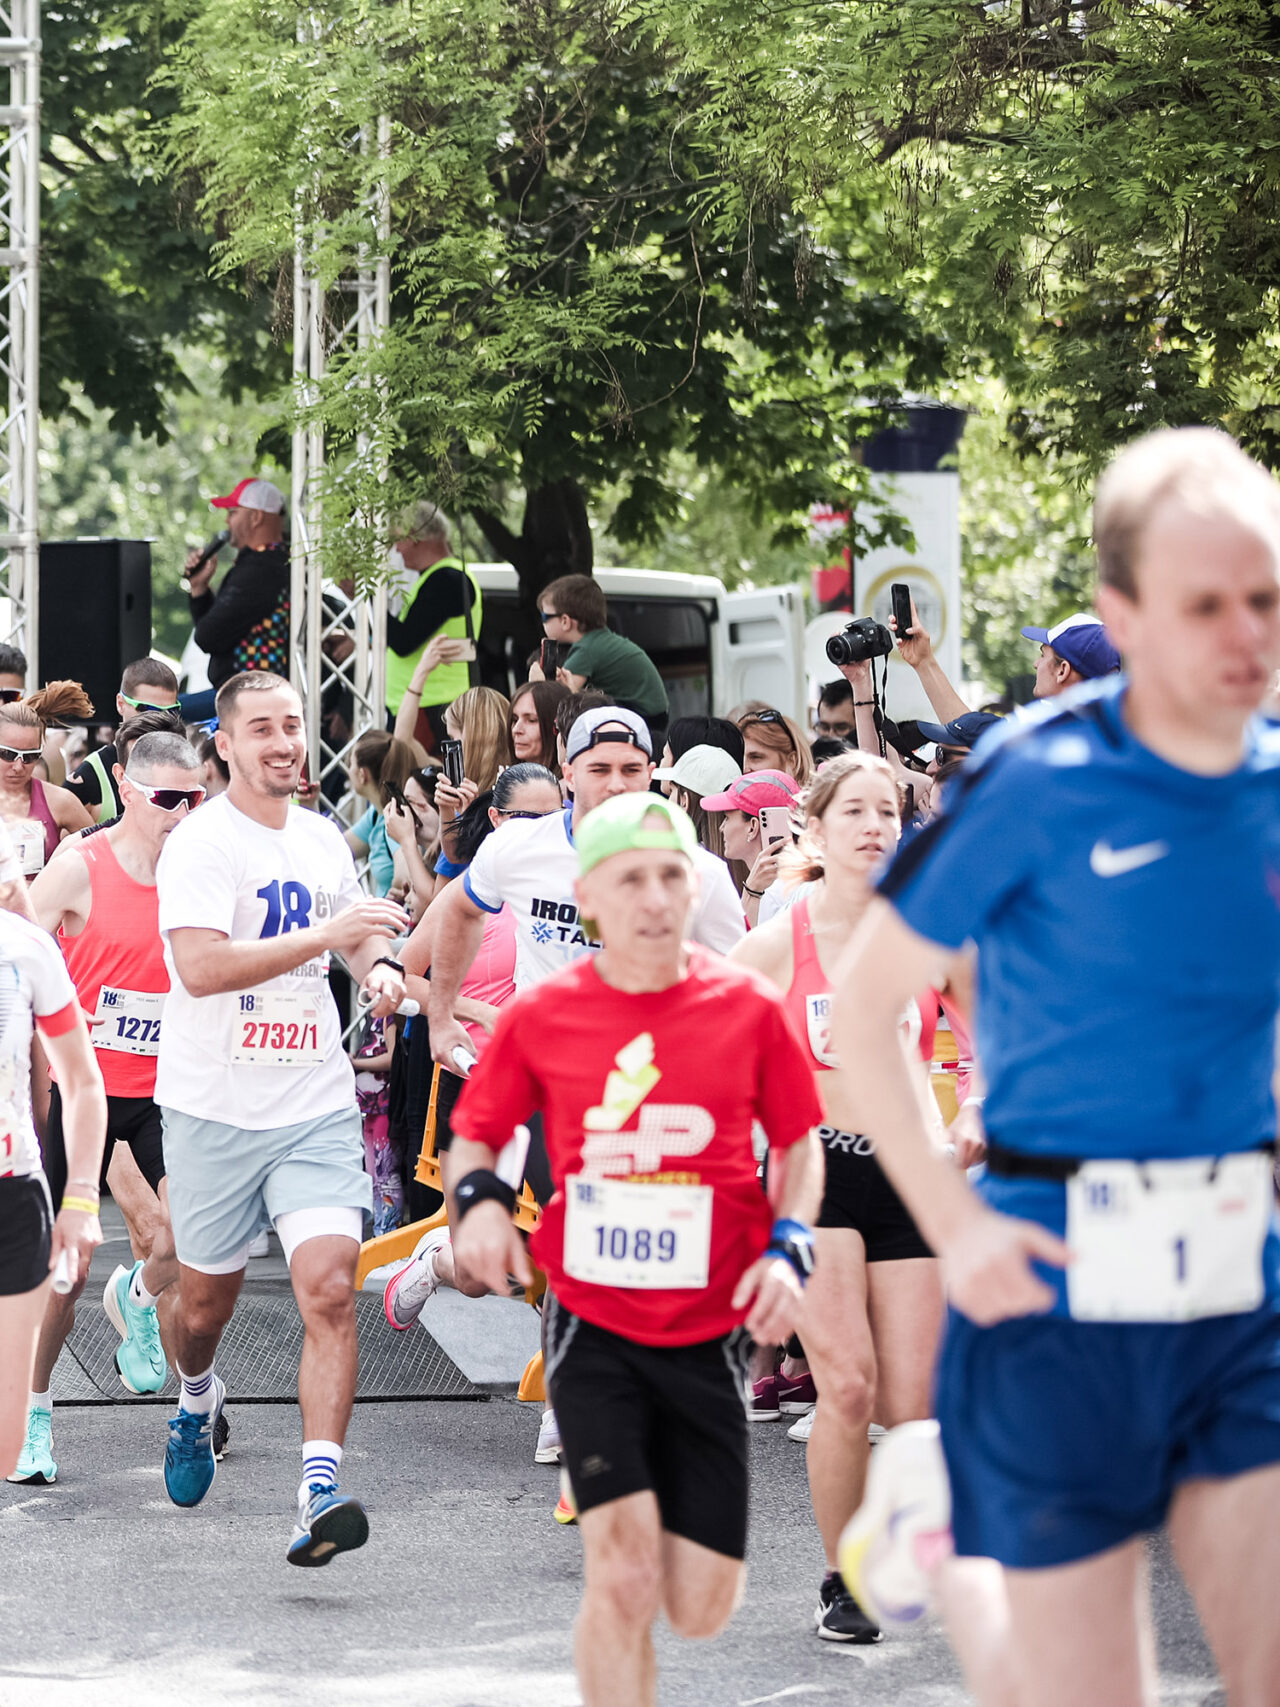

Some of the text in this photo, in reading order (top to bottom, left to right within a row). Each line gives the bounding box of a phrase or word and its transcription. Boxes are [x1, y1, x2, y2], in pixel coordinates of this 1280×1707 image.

[256, 879, 312, 939] 18
[531, 897, 582, 925] IRO
[557, 926, 604, 949] TAL
[103, 991, 118, 1006] 18
[238, 994, 255, 1012] 18
[812, 1000, 830, 1017] 18
[116, 1015, 161, 1042] 1272
[242, 1022, 317, 1050] 2732/1
[595, 1226, 676, 1262] 1089
[1175, 1236, 1186, 1285] 1
